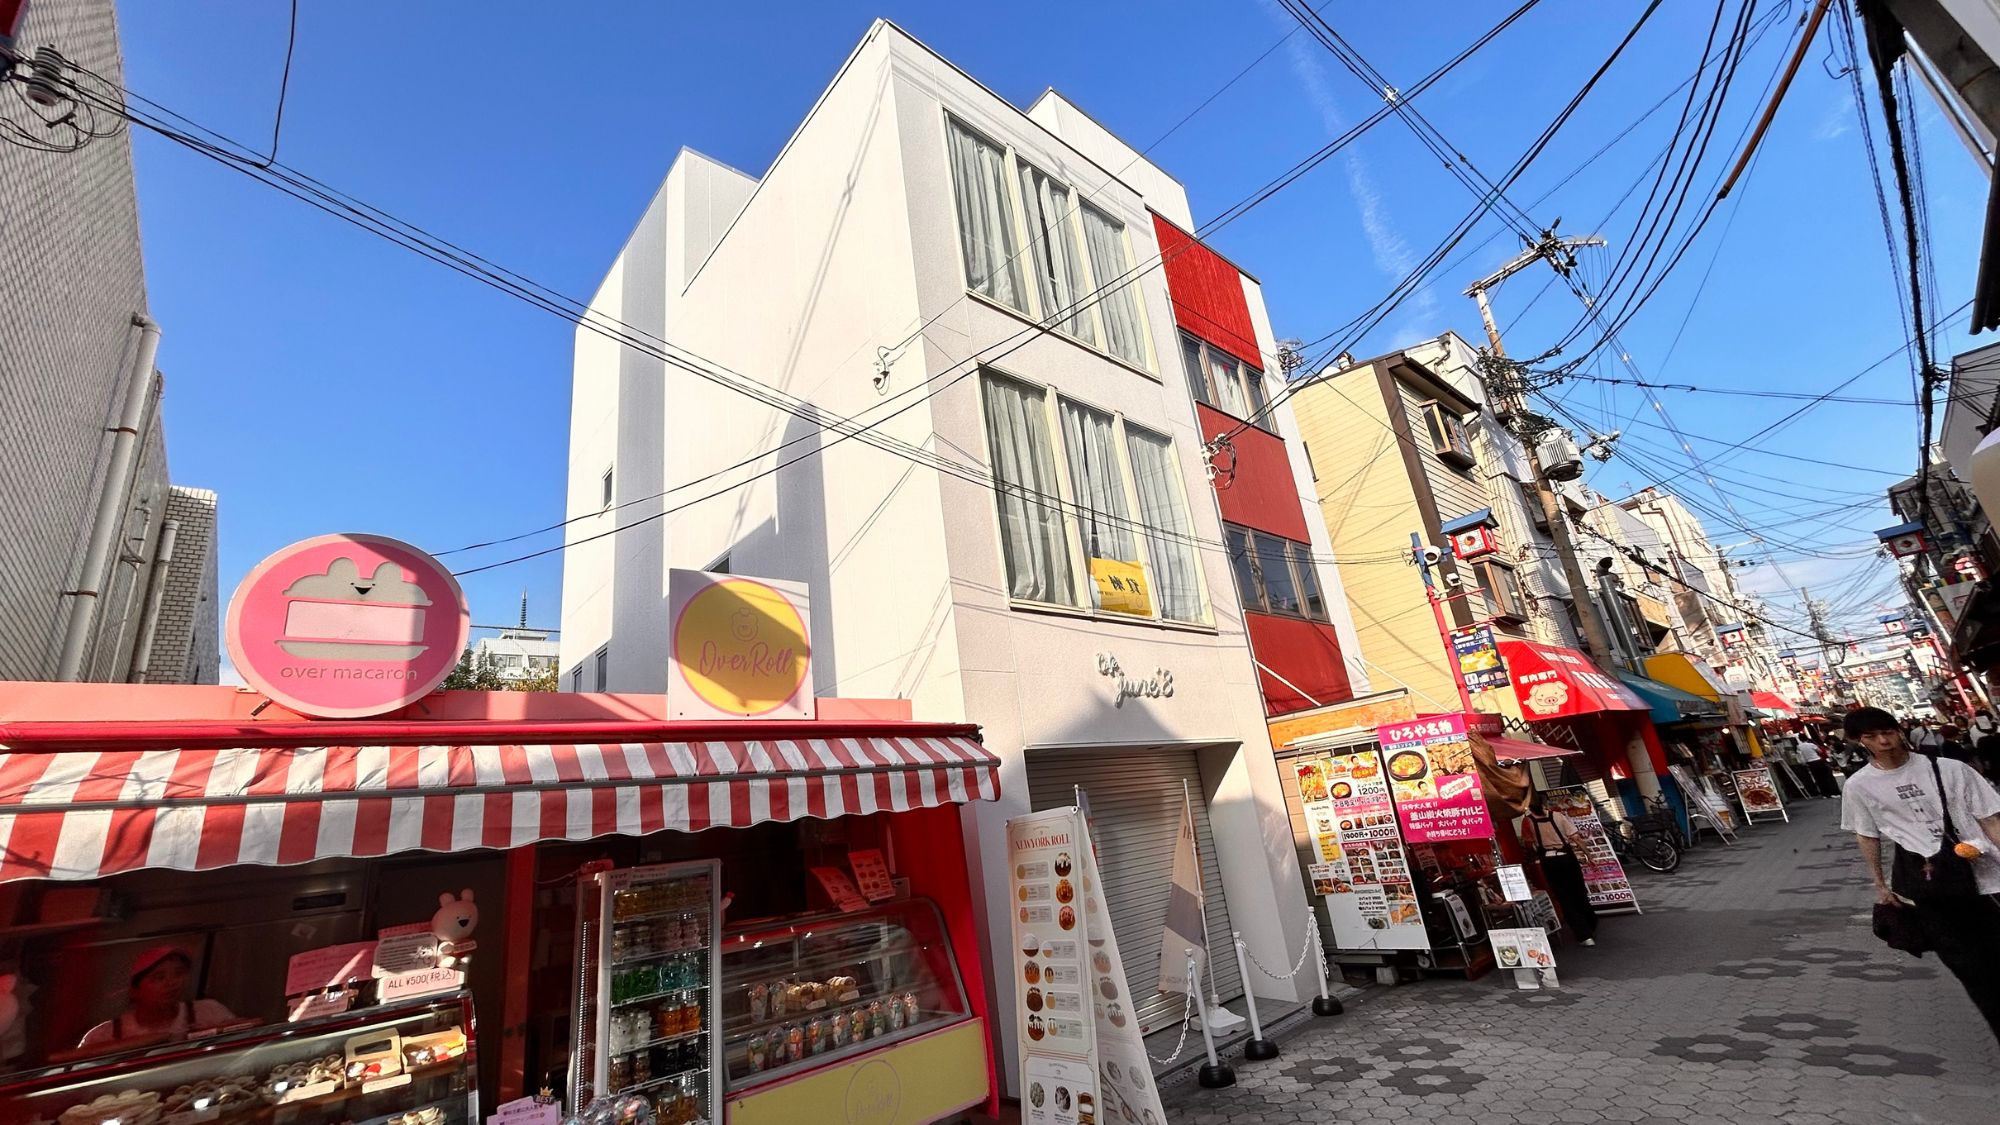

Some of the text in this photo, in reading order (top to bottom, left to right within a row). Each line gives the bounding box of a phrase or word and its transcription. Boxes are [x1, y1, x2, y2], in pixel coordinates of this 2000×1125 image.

[280, 667, 417, 681] over macaron
[1388, 719, 1454, 742] ひろや名物
[1357, 786, 1386, 796] 1200円
[388, 978, 404, 989] ALL
